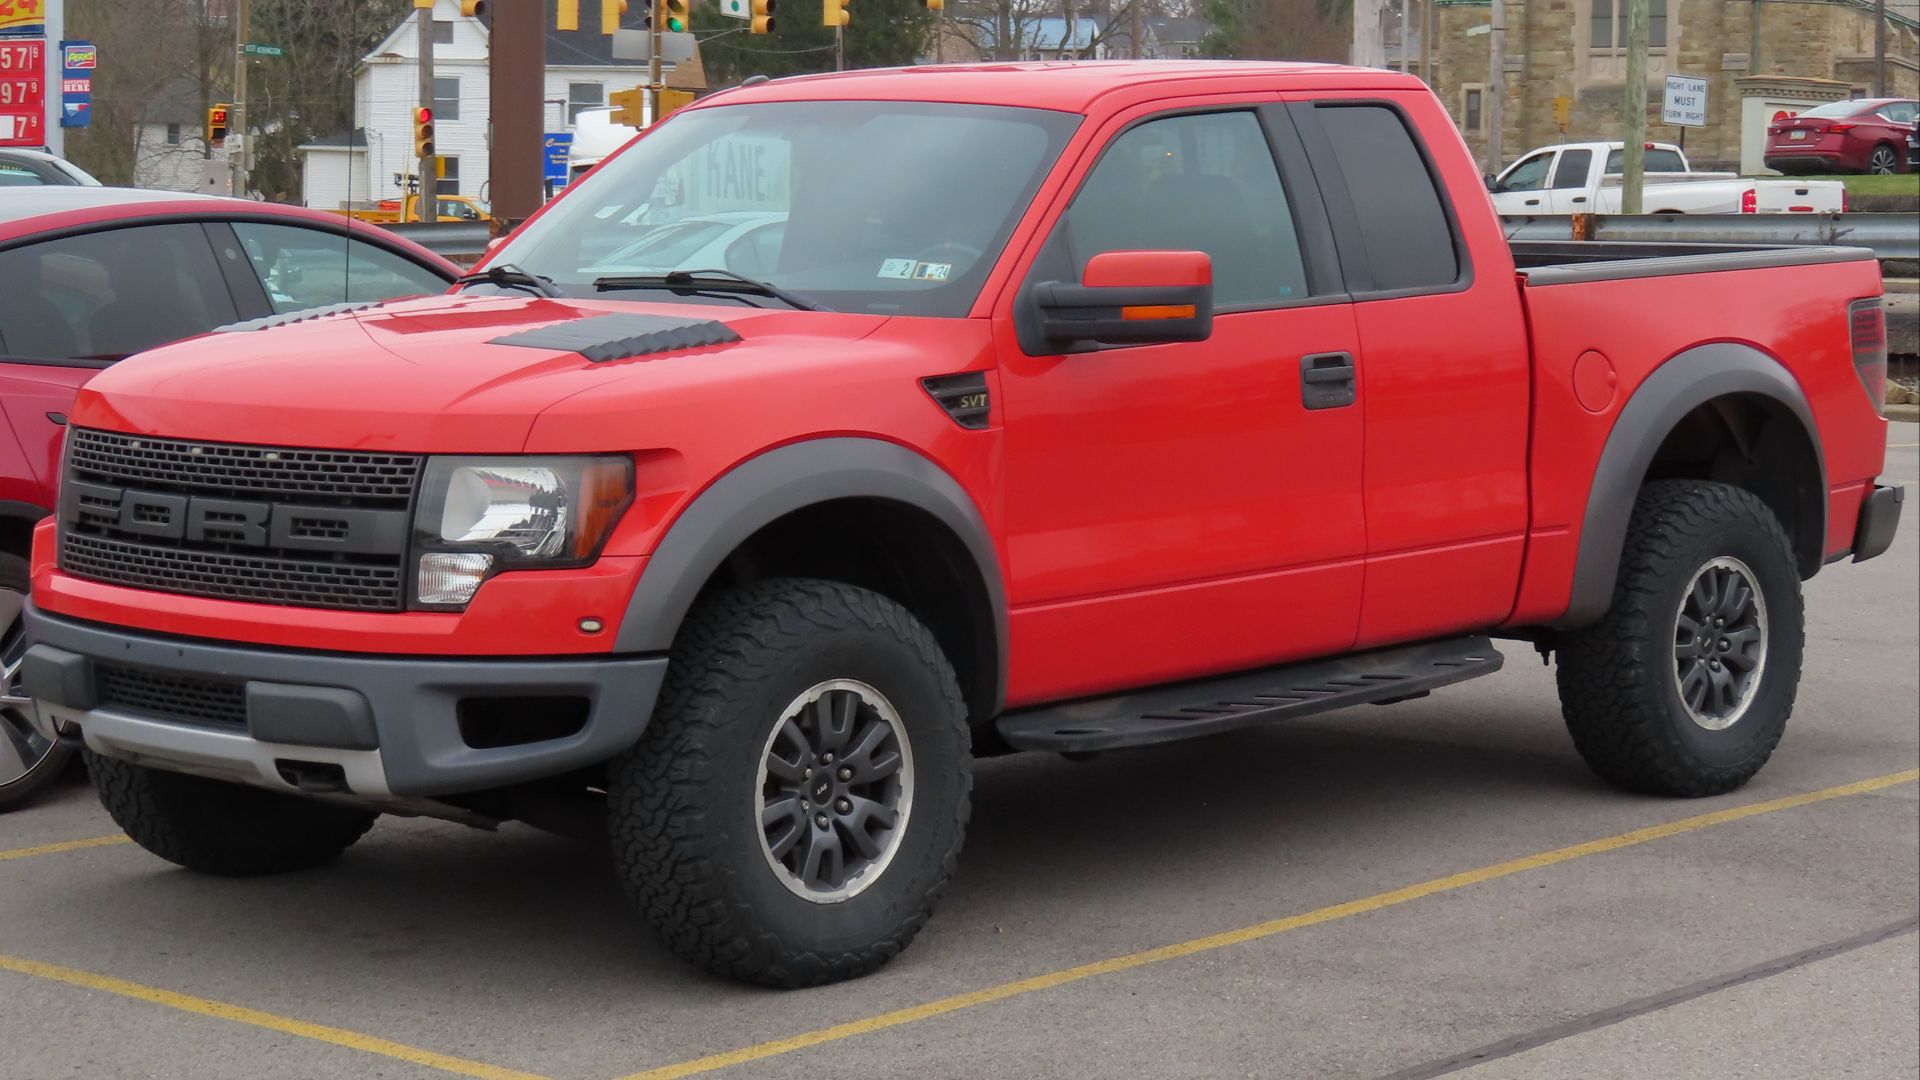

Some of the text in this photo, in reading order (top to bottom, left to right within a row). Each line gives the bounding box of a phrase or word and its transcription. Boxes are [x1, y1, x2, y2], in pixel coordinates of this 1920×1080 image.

[64, 84, 90, 92] HERE
[1667, 81, 1705, 93] RIGHT LANE
[1674, 95, 1696, 106] MUST
[1664, 109, 1704, 120] TURN RIGHT
[900, 262, 910, 276] 2
[961, 393, 987, 408] SVT
[65, 480, 405, 554] FORD
